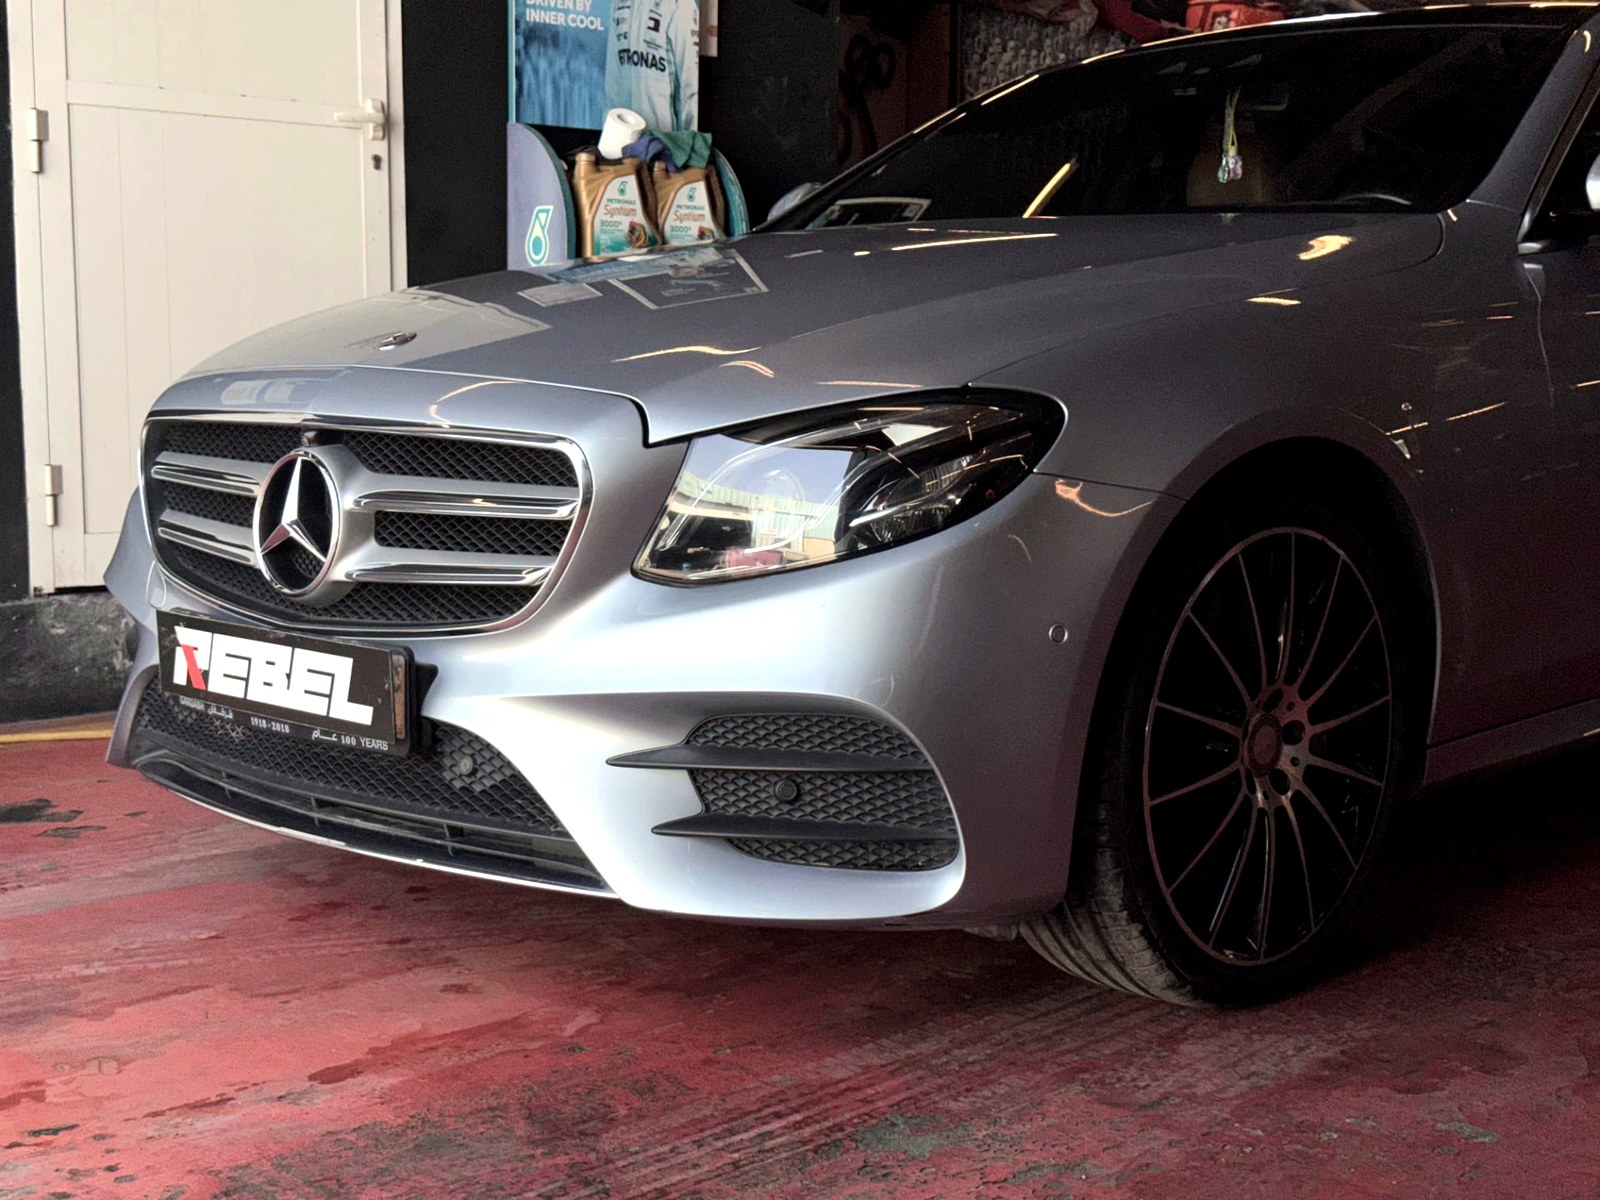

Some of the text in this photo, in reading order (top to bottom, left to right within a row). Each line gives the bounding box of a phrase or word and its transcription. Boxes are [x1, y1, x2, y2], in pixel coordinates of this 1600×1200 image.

[526, 0, 592, 13] DRIVEN BY
[526, 8, 565, 26] INNER
[568, 13, 605, 31] COOL
[604, 204, 637, 218] Syntium
[673, 210, 706, 223] Syntium
[173, 625, 374, 726] REBEL
[250, 716, 290, 734] 1918-2018
[341, 734, 357, 746] 100
[359, 737, 389, 751] YEARS
